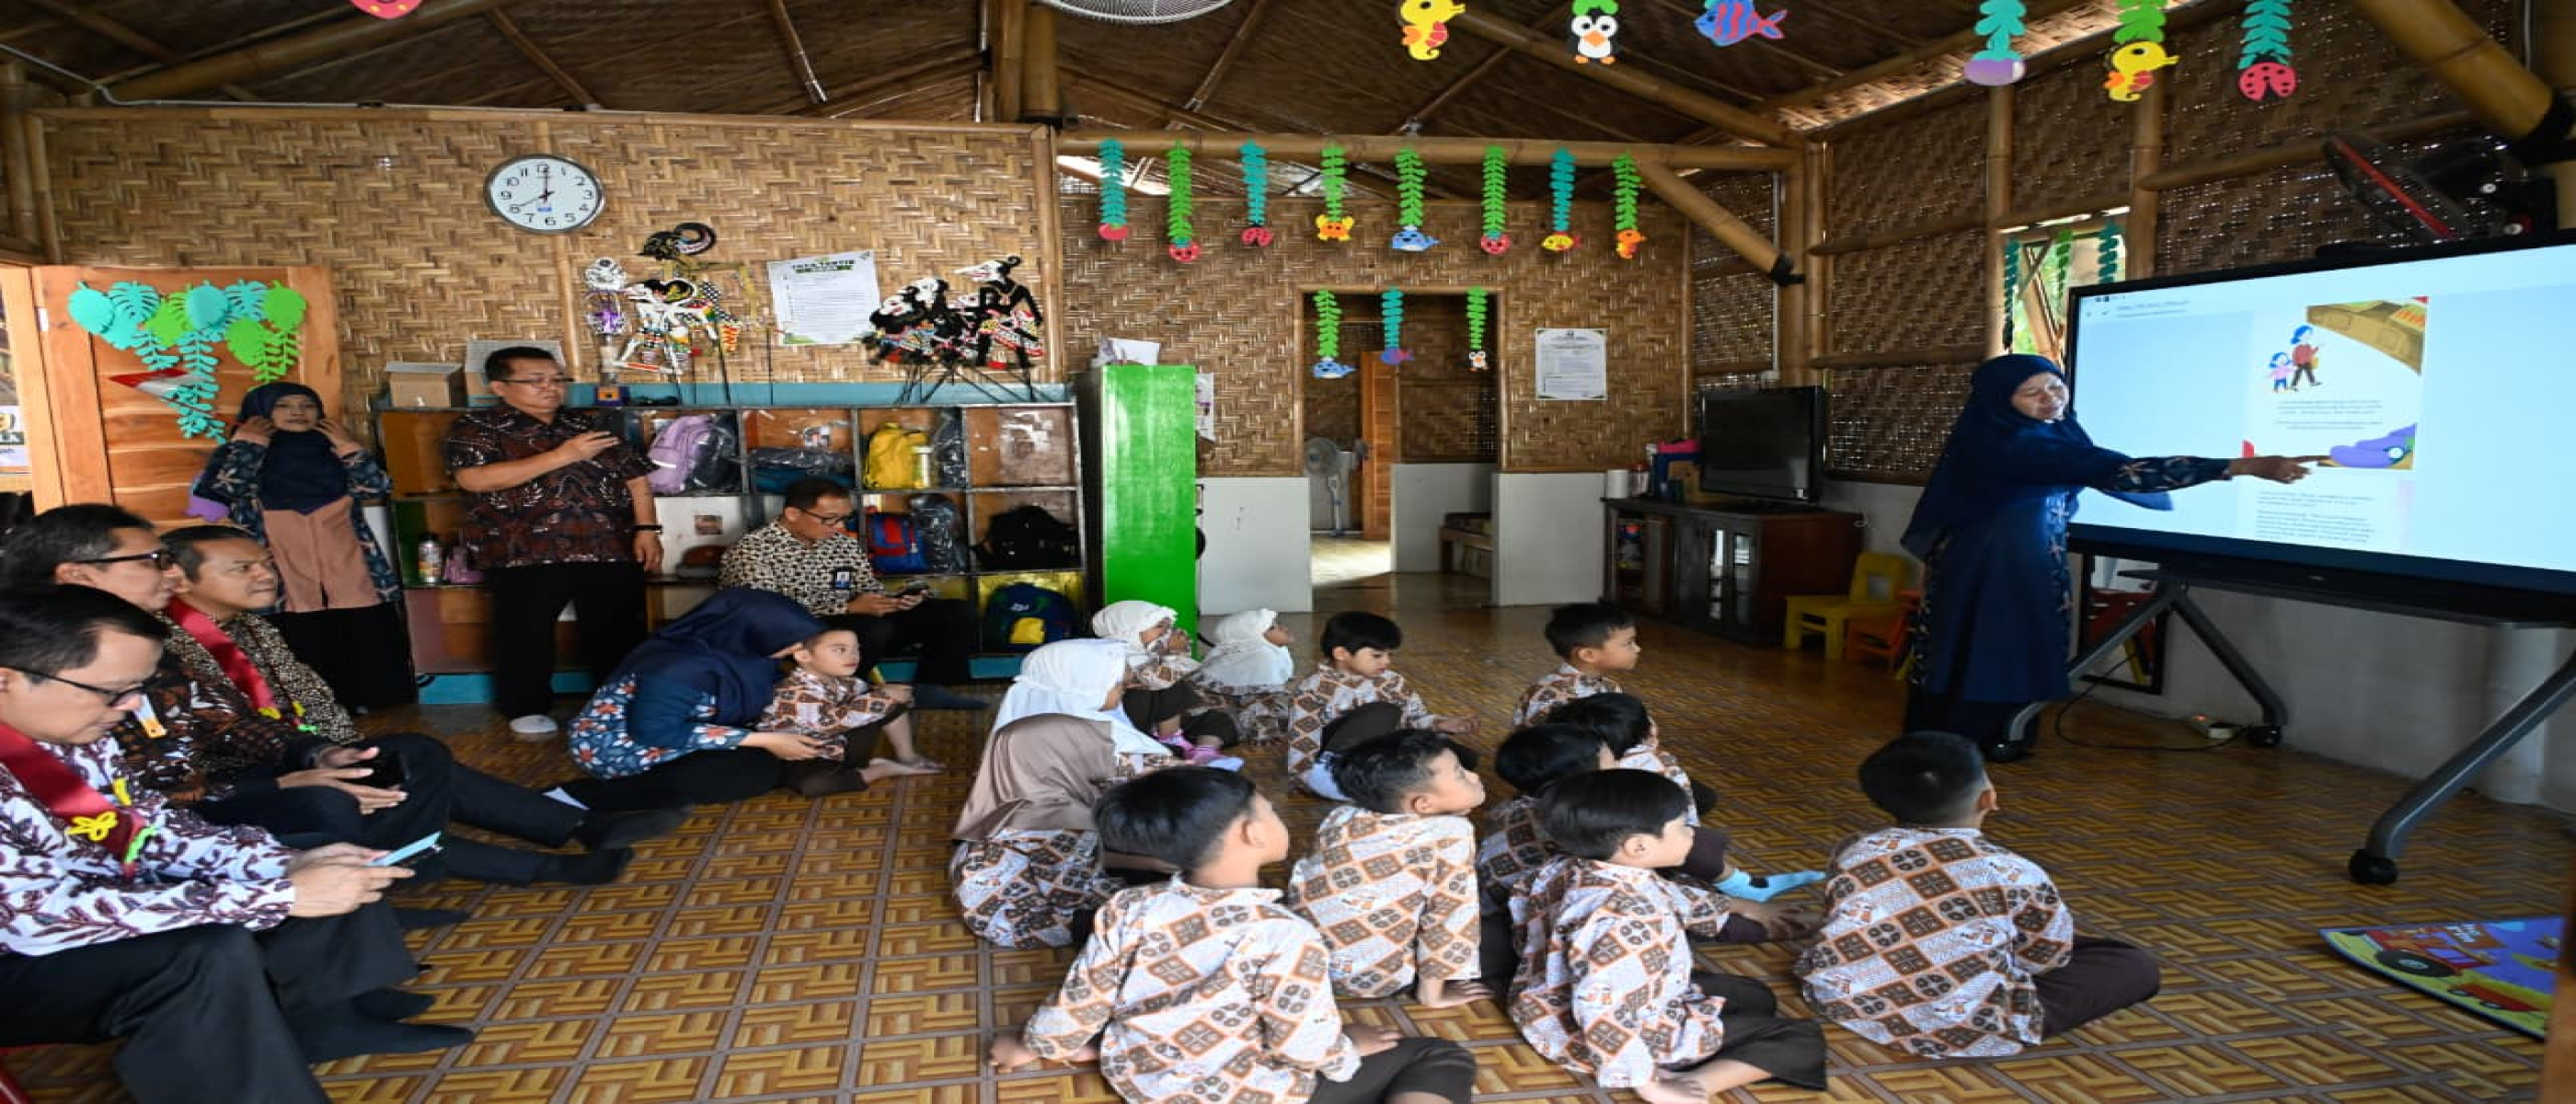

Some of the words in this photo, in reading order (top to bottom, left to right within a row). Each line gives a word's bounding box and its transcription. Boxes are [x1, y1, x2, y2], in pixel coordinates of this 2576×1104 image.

[574, 176, 586, 186] 2
[500, 190, 512, 200] 9
[583, 190, 592, 200] 3
[524, 213, 535, 223] 7
[545, 217, 556, 226] 6
[565, 213, 576, 223] 5
